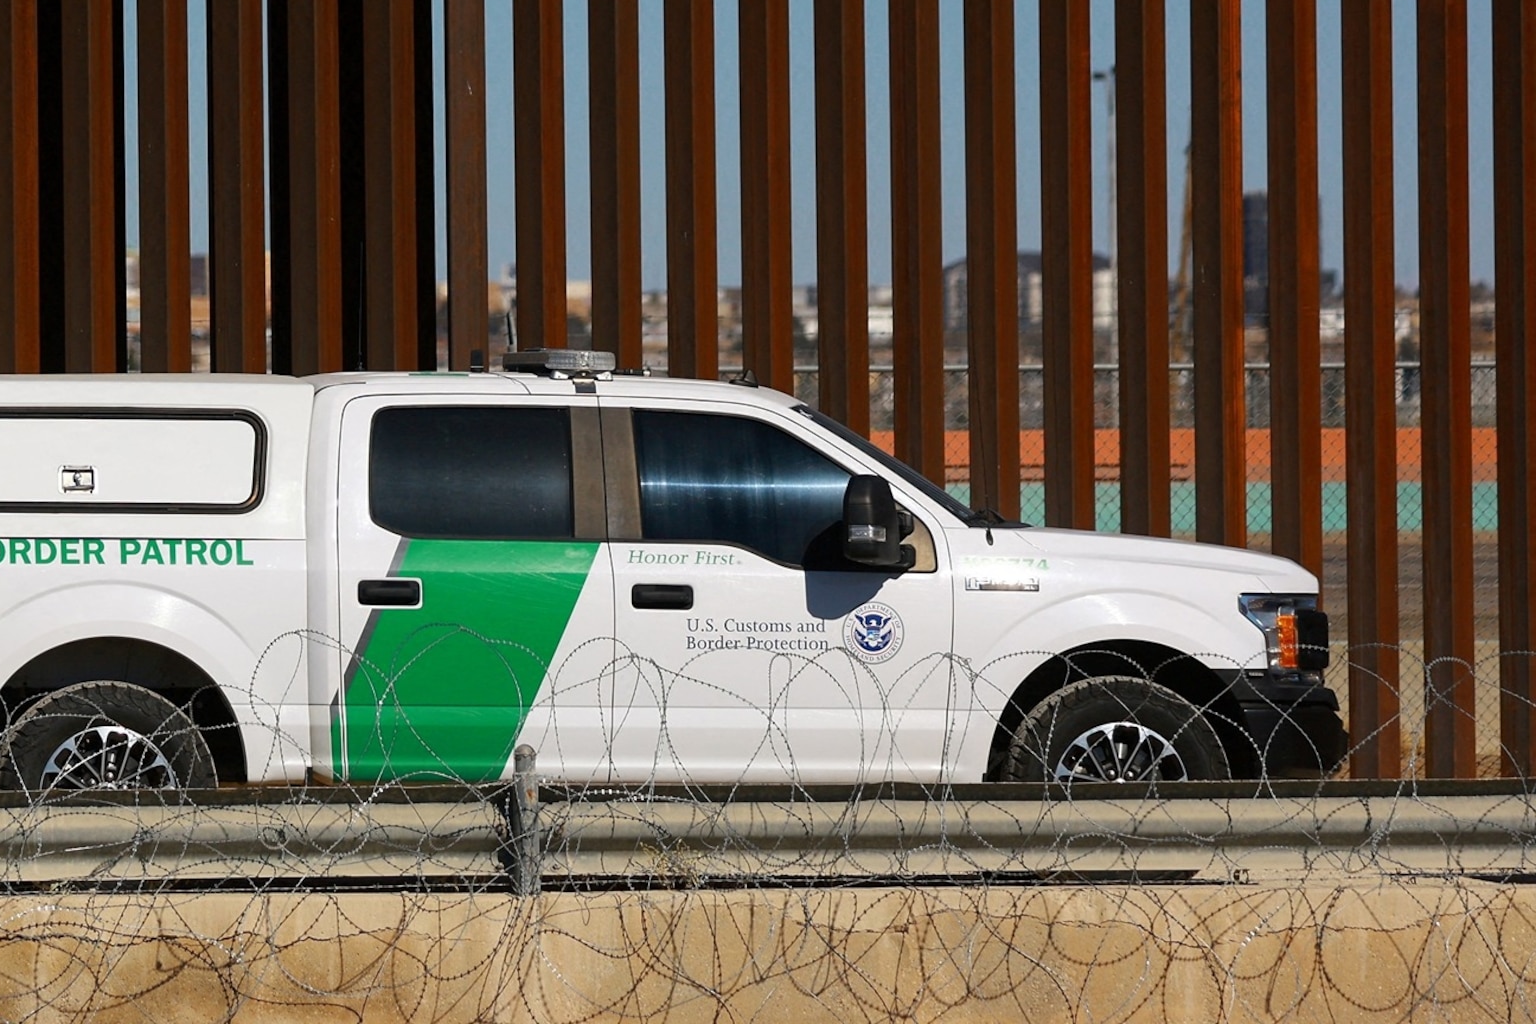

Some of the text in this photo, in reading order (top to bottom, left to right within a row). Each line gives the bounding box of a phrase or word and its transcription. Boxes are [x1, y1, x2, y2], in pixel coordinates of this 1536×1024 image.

[120, 538, 254, 566] PATROL
[627, 549, 689, 565] Honor
[686, 618, 826, 632] U.S. Customs and
[855, 604, 897, 620] DEPARTMENT
[894, 620, 901, 629] OF
[686, 635, 829, 651] Border Protection
[845, 635, 901, 662] HOMELAND SECURITY
